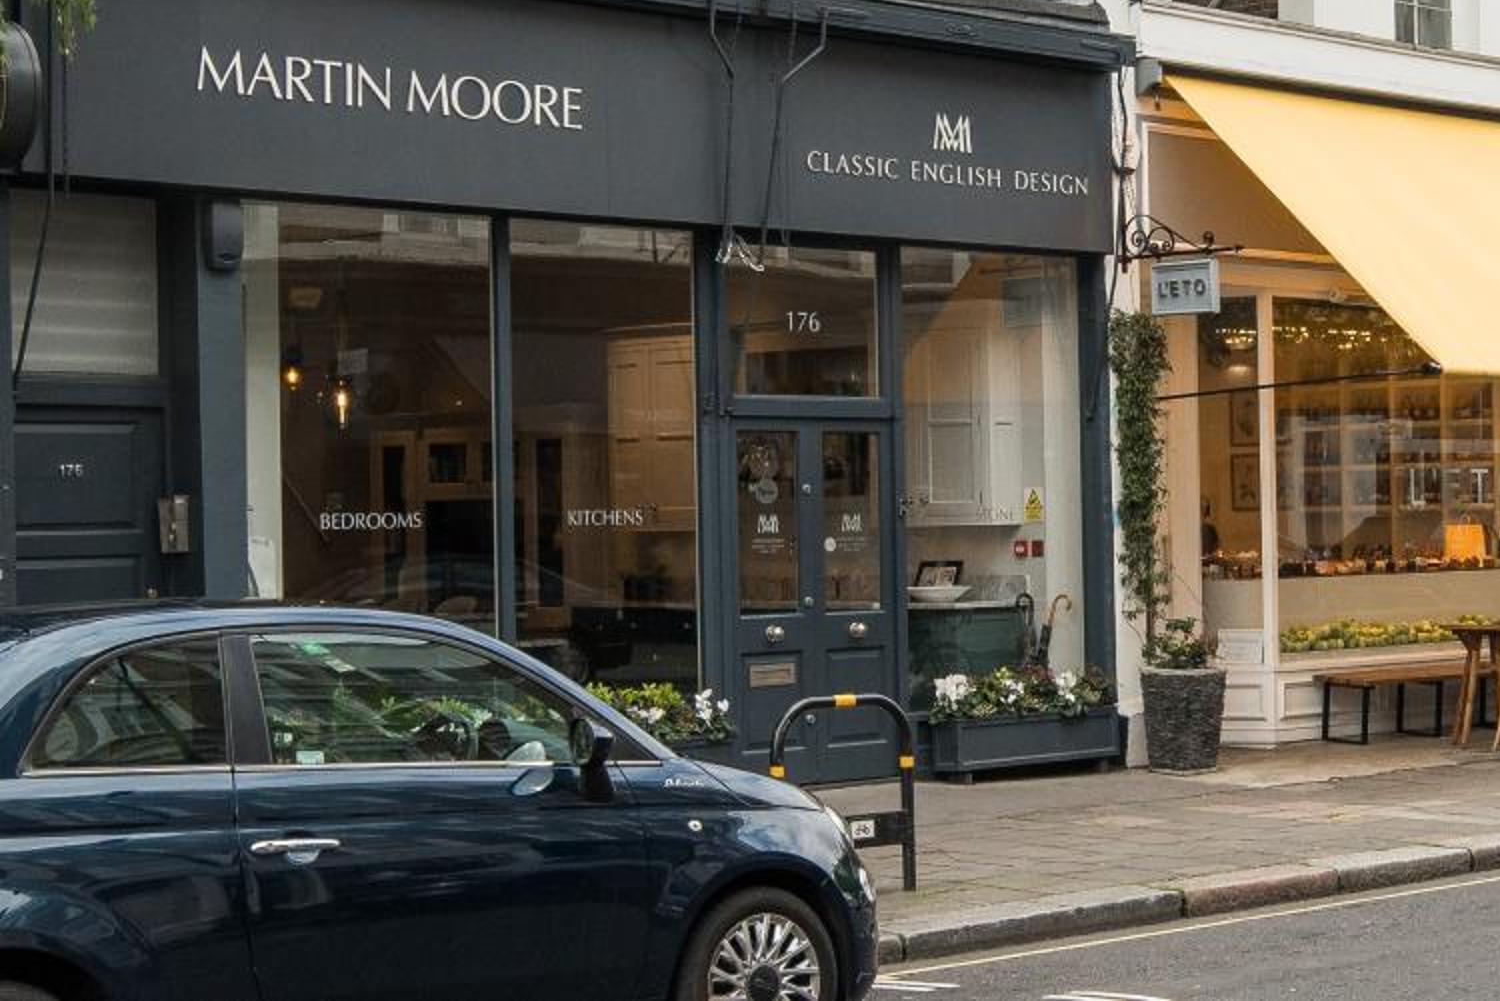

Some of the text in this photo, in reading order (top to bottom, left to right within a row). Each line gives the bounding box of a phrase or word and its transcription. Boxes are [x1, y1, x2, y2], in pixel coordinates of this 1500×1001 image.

[197, 45, 584, 130] MARTIN MOORE
[806, 150, 1089, 196] CLASSIC ENGLISH DESIGN
[1157, 278, 1207, 298] L'ETO
[785, 310, 821, 333] 176
[319, 511, 423, 530] BEDROOMS
[567, 509, 645, 527] KITCHENS
